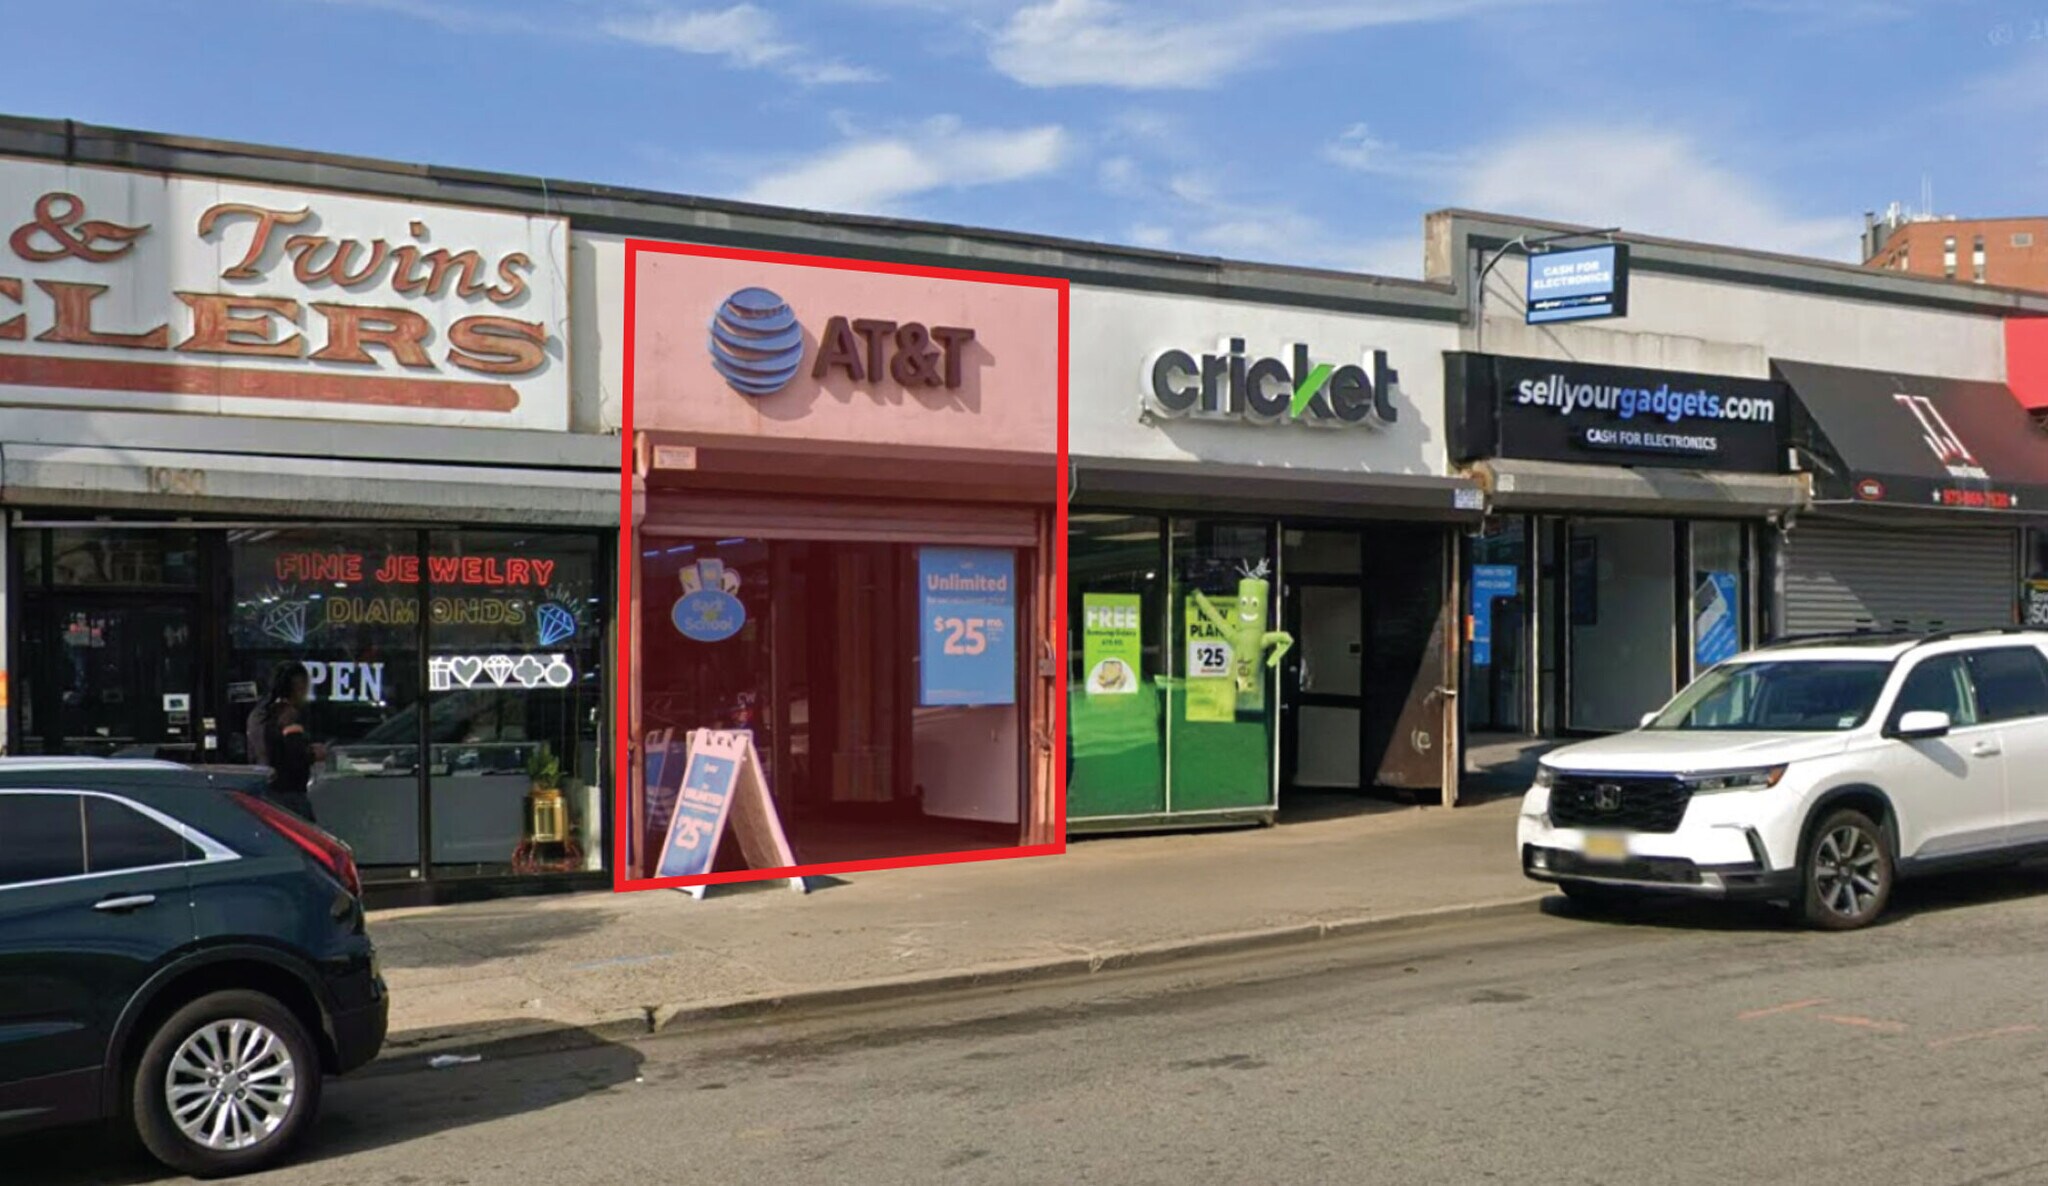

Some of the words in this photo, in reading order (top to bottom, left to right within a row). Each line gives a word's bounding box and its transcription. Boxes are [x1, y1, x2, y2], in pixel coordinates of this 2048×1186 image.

[9, 192, 152, 263] &
[199, 202, 534, 302] Twins
[1534, 271, 1609, 289] ELECTRONICS
[1543, 263, 1575, 277] CASH
[1576, 260, 1600, 274] FOR
[811, 315, 976, 390] AT&T
[1148, 337, 1400, 424] cricket
[1517, 374, 1775, 422] sellyourgadgets.com
[1586, 428, 1617, 443] CASH
[1619, 431, 1642, 446] FOR
[1643, 434, 1718, 451] ELECTRONICS
[276, 553, 363, 582] FINE
[376, 555, 554, 586] JEWELRY
[927, 572, 1008, 592] Unlimited
[326, 597, 526, 624] DIAMONDS
[1086, 606, 1138, 630] FREE
[1198, 609, 1229, 623] NW
[934, 616, 987, 656] $25
[1197, 647, 1225, 667] $25
[301, 660, 384, 701] PEN
